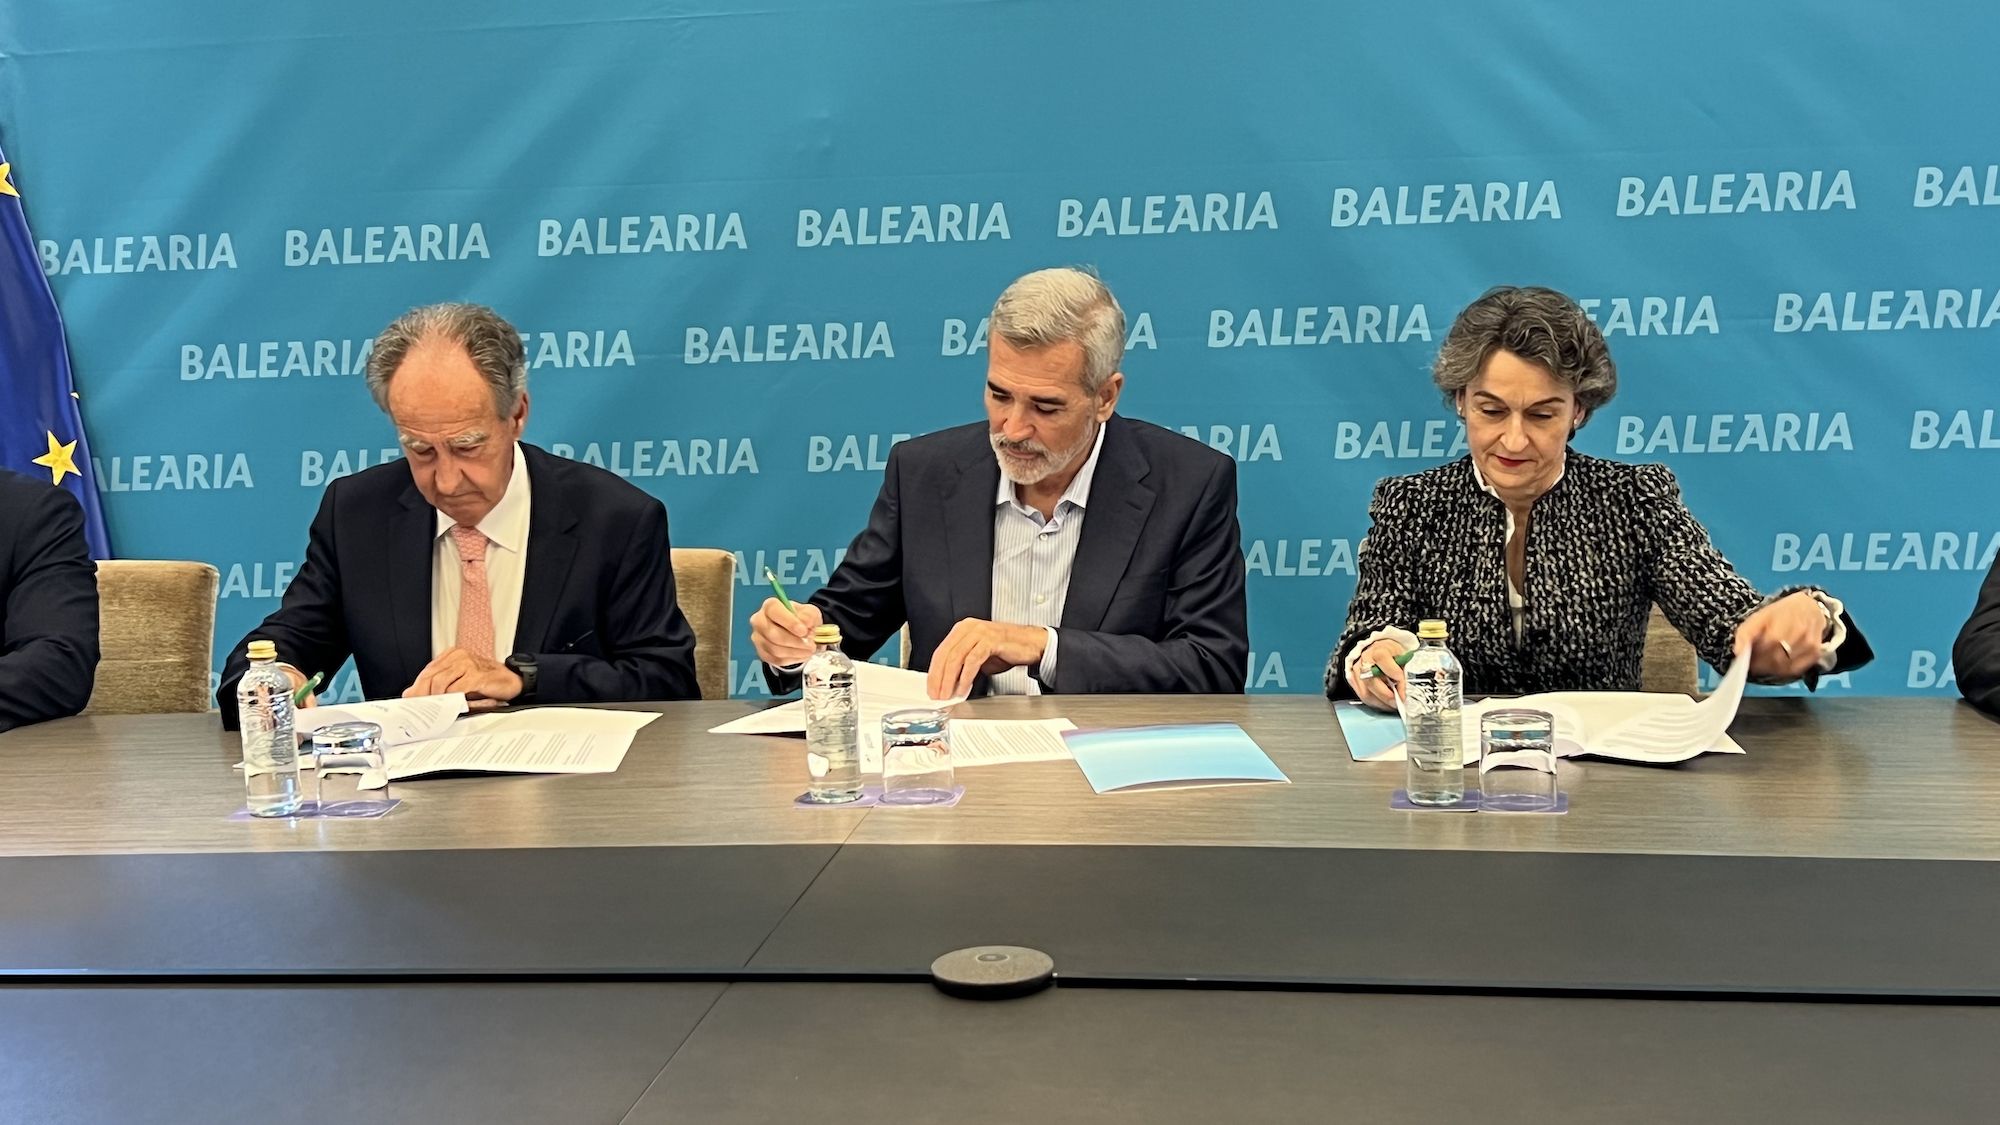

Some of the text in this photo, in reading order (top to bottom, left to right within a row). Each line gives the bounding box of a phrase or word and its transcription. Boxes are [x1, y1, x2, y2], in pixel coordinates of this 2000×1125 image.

[1331, 181, 1561, 227] BALEARIA
[1617, 170, 1856, 216] BALEARIA
[538, 213, 747, 256] BALEARIA
[797, 202, 1010, 247] BALEARIA
[1058, 192, 1278, 237] BALEARIA
[41, 233, 237, 275] BALEARIA
[285, 223, 490, 266] BALEARIA
[1208, 304, 1432, 347] BALEARIA
[1582, 296, 1719, 336] EARIA
[522, 330, 635, 368] ARIA
[685, 322, 894, 363] BALEARIA
[1335, 420, 1468, 459] BALEA
[1616, 412, 1853, 454] BALEARIA
[93, 453, 253, 491] LEARIA
[734, 548, 846, 585] ALEA
[1245, 539, 1355, 576] ALEA
